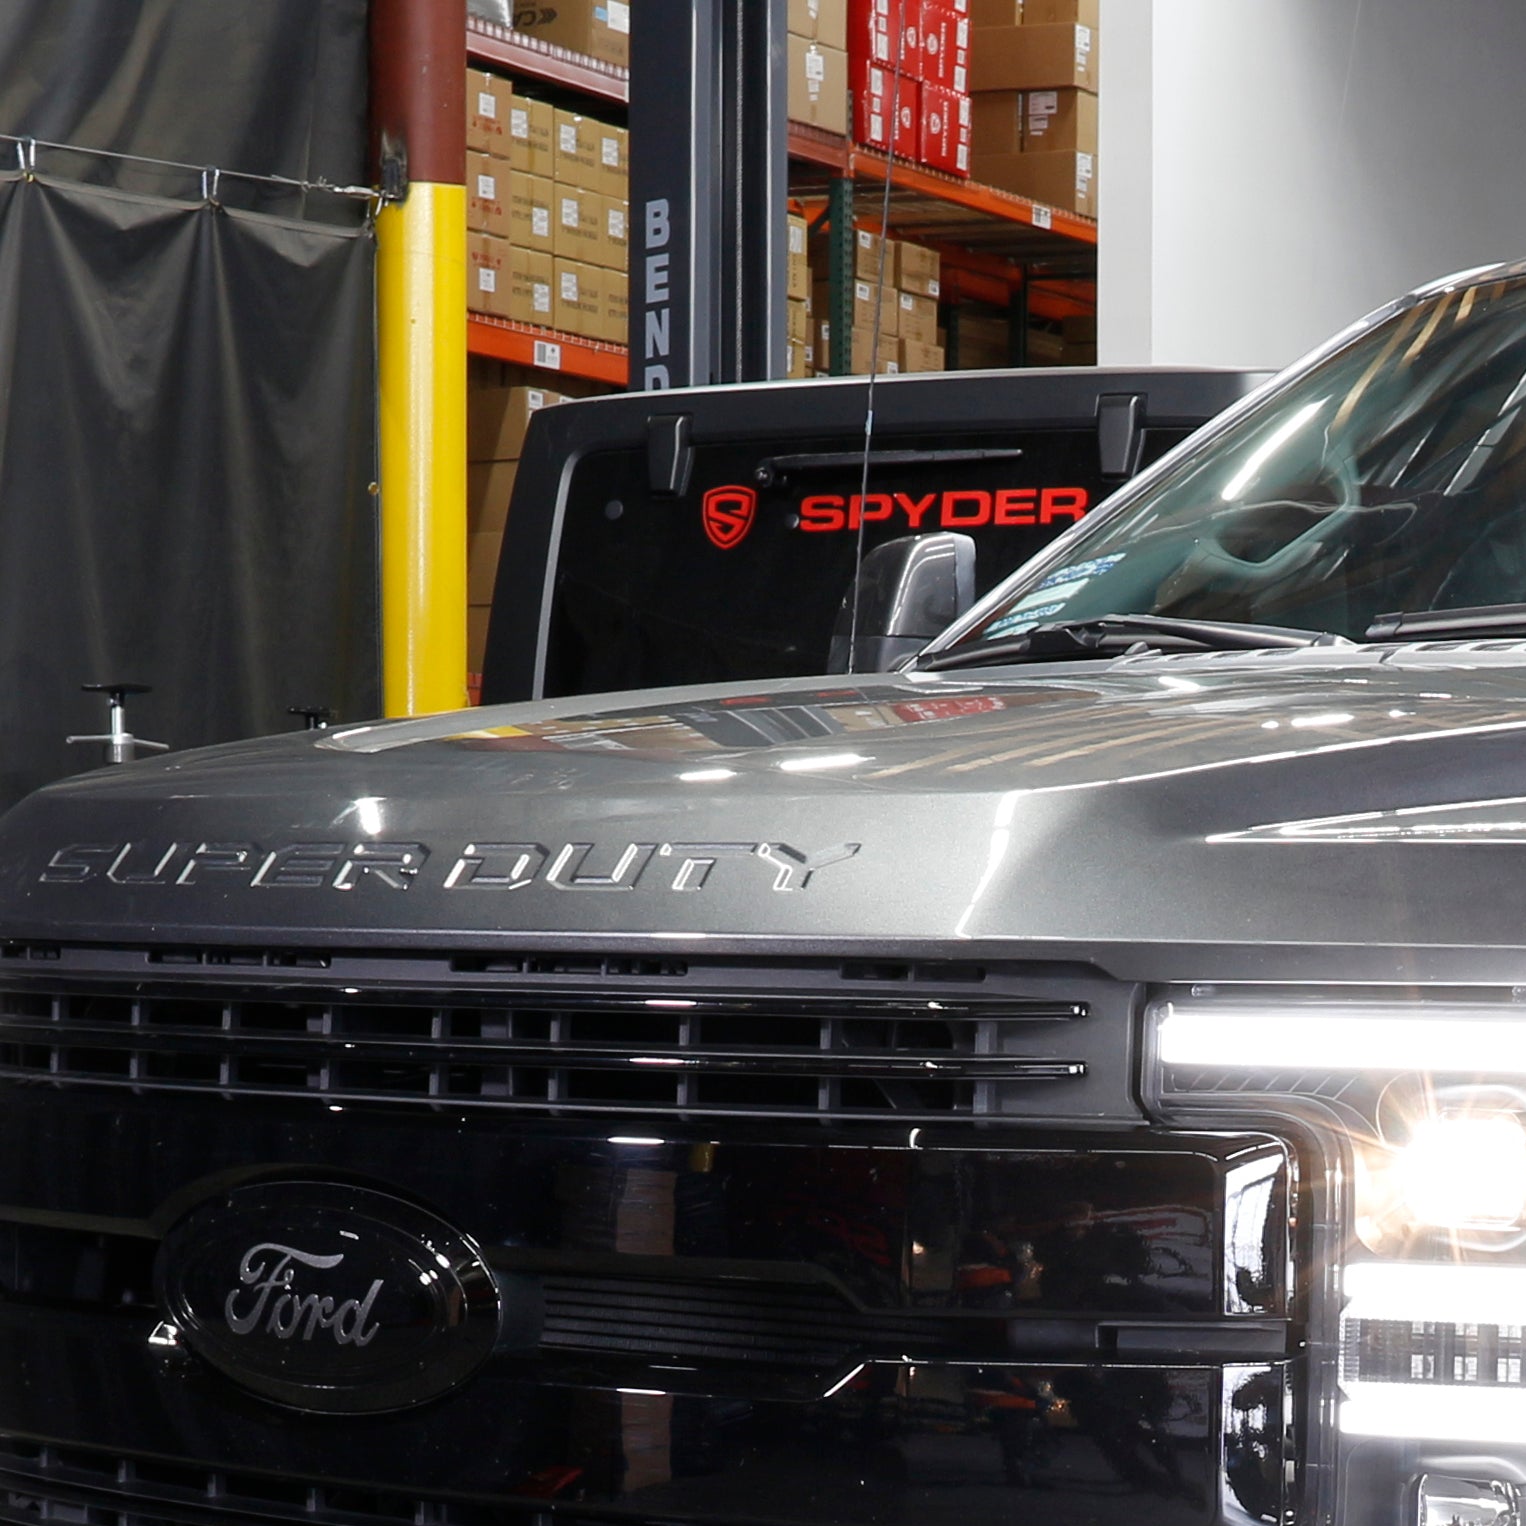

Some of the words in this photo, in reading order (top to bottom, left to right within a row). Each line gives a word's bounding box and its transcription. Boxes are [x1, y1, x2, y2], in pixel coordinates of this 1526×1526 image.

[800, 487, 1089, 532] SPYDER
[38, 842, 431, 891] SUPER
[443, 842, 862, 892] DUTY
[225, 1242, 385, 1348] Ford
